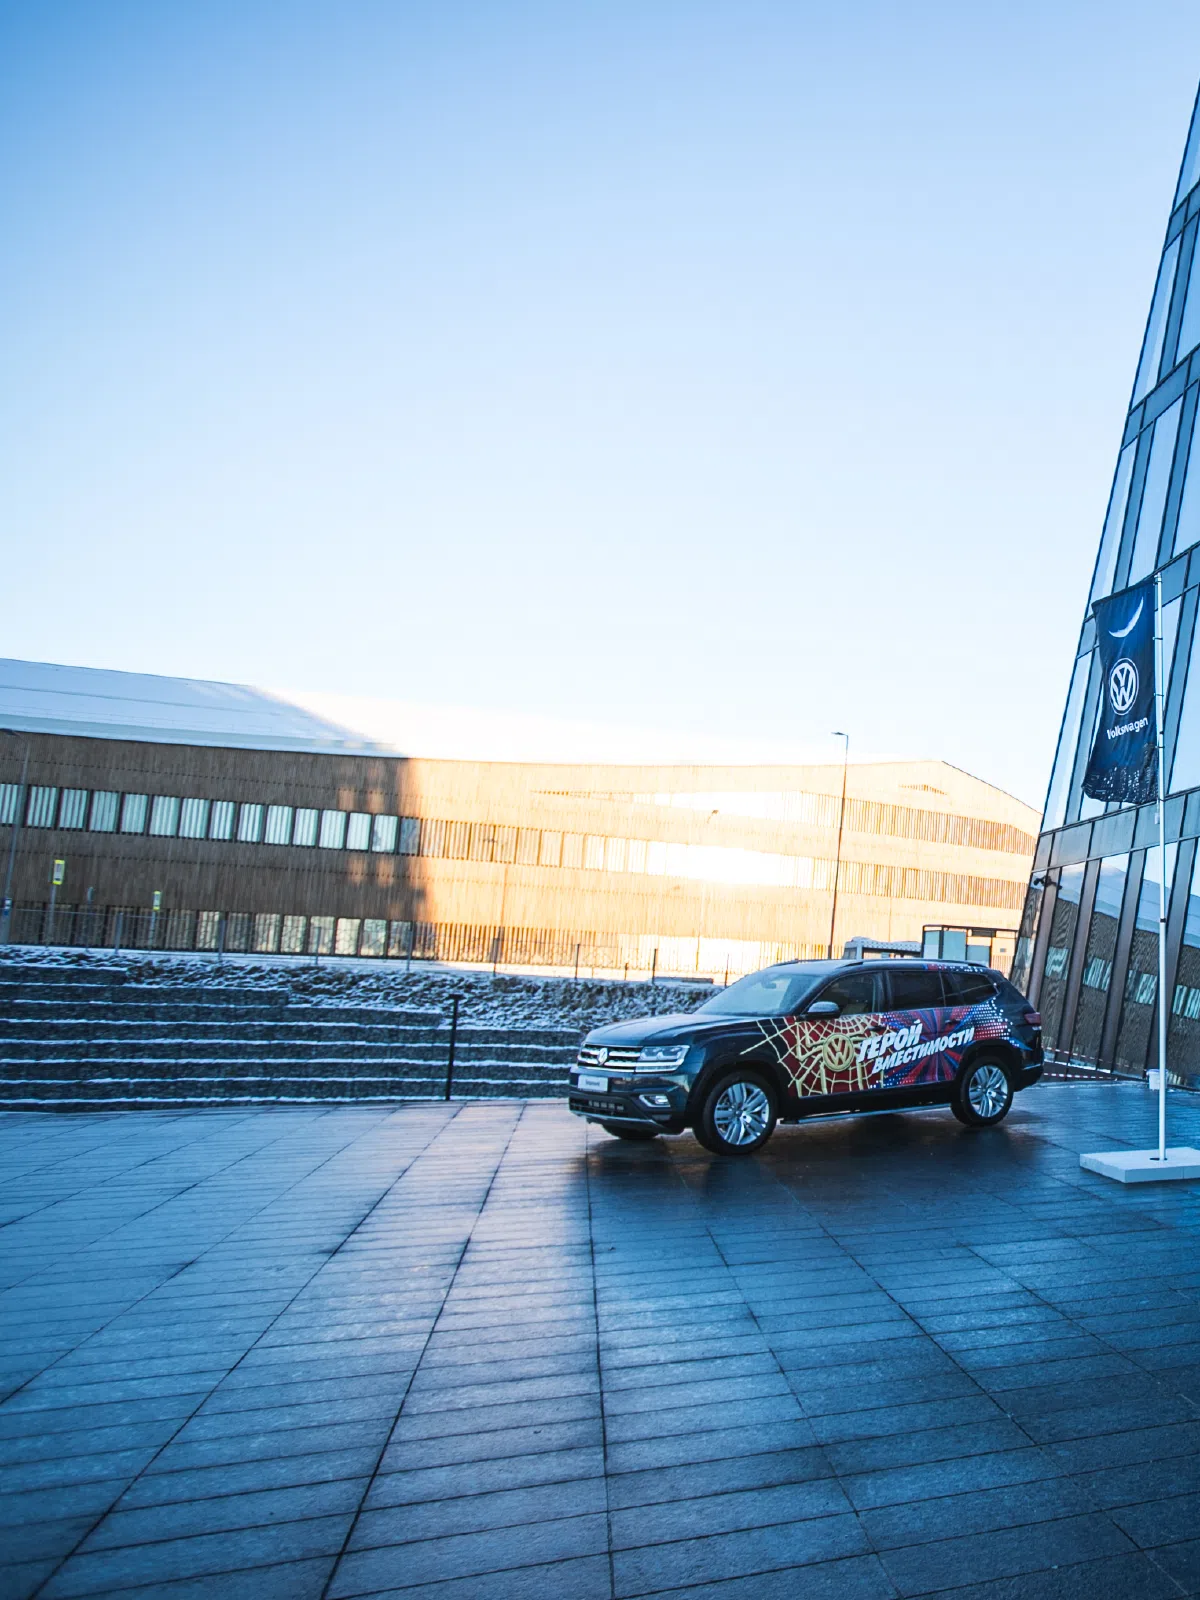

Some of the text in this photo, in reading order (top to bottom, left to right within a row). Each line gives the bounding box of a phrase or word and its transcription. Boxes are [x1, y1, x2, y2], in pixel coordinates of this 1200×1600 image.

[1110, 661, 1137, 711] VW
[1106, 716, 1149, 740] Volkswagen
[823, 1033, 855, 1072] VW
[856, 1019, 923, 1063] ГЕРОЙ
[872, 1027, 975, 1075] ВМЕСТИМОСТИ
